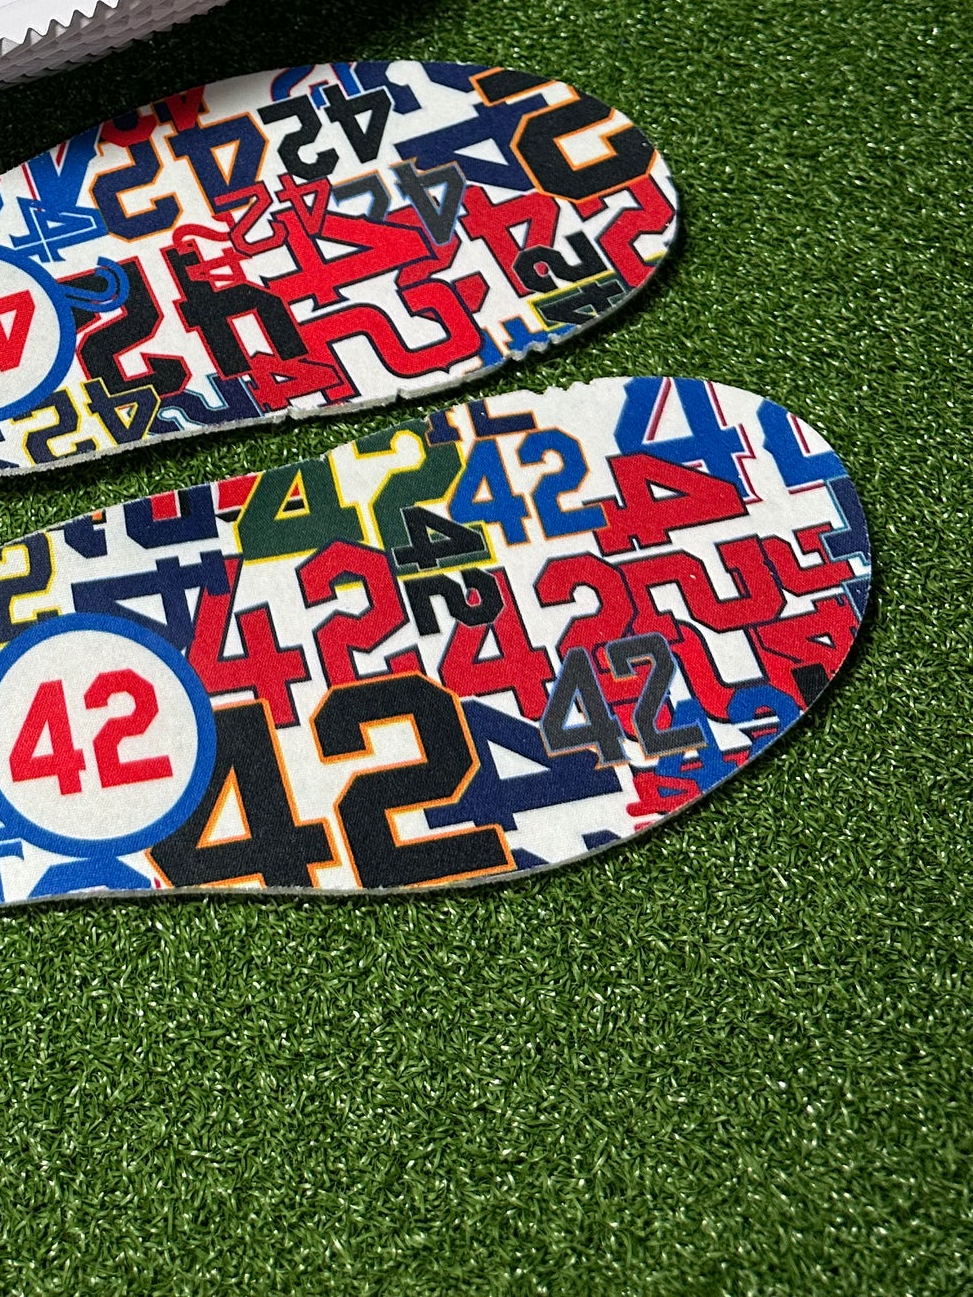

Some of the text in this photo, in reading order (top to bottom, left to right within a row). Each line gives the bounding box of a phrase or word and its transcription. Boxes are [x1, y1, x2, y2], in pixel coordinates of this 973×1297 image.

[88, 100, 270, 243] 42
[257, 83, 394, 180] 42
[214, 172, 332, 258] 42
[11, 377, 162, 467] 42
[447, 426, 609, 546] 42
[233, 416, 497, 580] 42
[187, 540, 427, 729] 42
[392, 505, 507, 637] 42
[9, 669, 174, 796] 42
[539, 632, 708, 770] 42
[149, 670, 517, 892] 42
